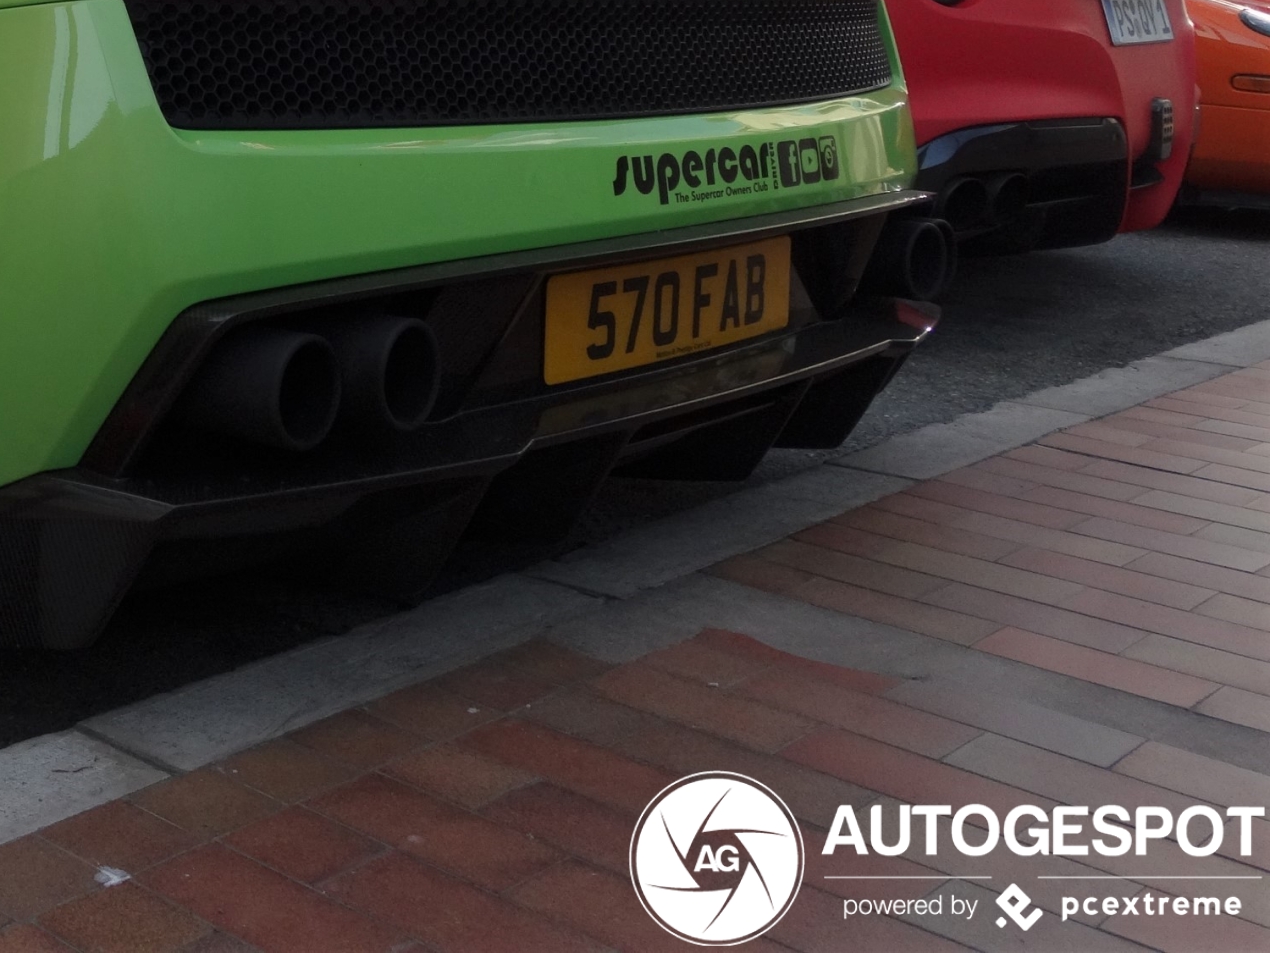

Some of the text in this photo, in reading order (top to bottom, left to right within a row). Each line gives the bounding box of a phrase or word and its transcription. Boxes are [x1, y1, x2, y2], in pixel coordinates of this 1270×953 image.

[612, 142, 768, 205] supercar
[675, 181, 769, 203] The Supercar Owners Club
[586, 254, 766, 361] 570 FAB
